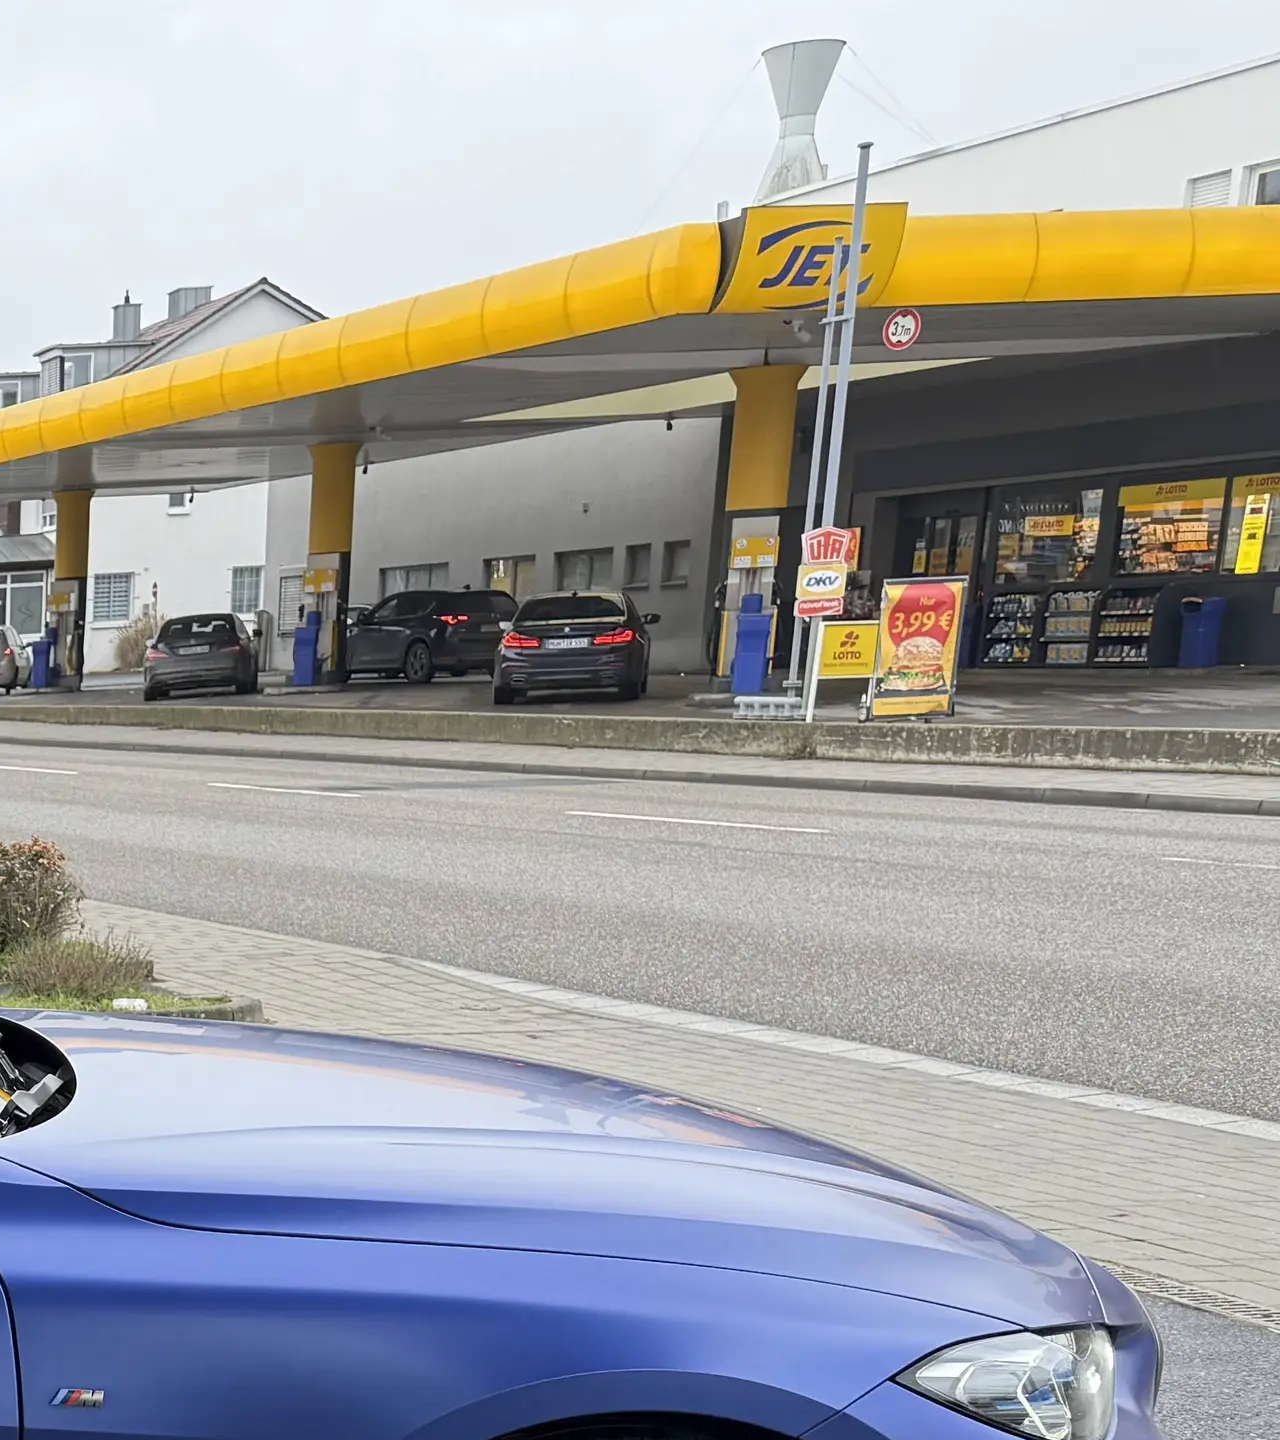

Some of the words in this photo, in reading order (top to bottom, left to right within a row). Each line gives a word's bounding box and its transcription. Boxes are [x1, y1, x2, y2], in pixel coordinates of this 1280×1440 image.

[1165, 485, 1188, 494] LOTTO
[808, 538, 844, 560] UTA
[806, 575, 840, 587] DKV
[920, 597, 936, 606] Nur
[892, 612, 936, 637] 3,99
[939, 610, 953, 631] €
[832, 651, 862, 660] LOTTO
